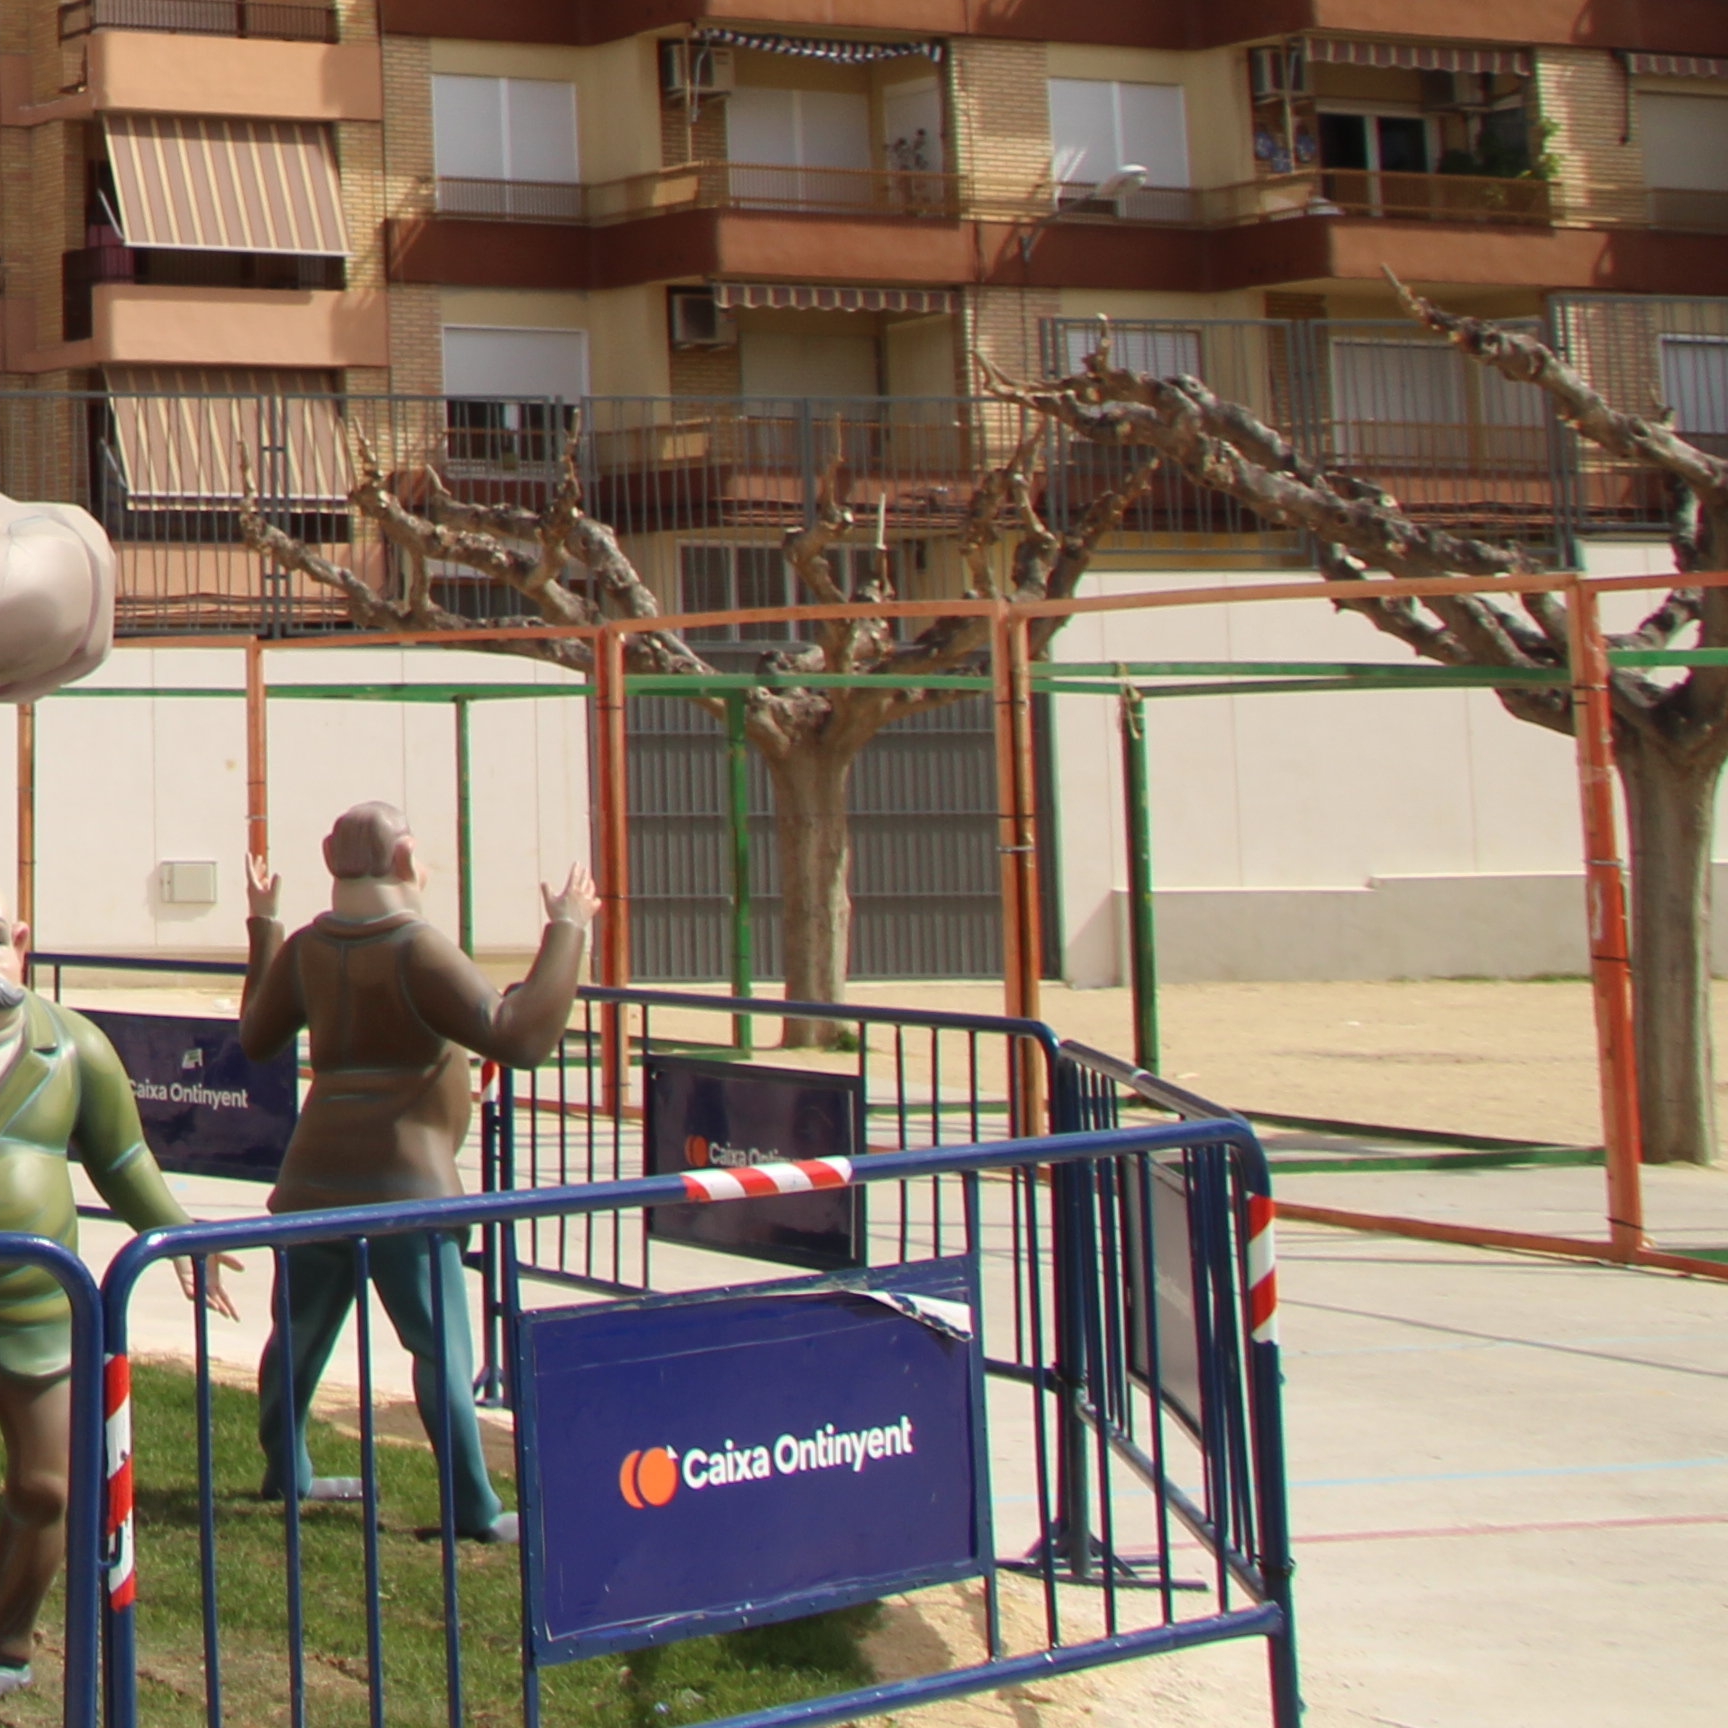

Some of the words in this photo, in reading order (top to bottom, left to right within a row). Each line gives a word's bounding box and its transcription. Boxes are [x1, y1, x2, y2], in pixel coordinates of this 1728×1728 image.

[170, 1083, 248, 1110] Ontinyent
[708, 1142, 747, 1166] Caixa
[682, 1439, 771, 1489] Caixa
[773, 1415, 913, 1473] Ontinyent
